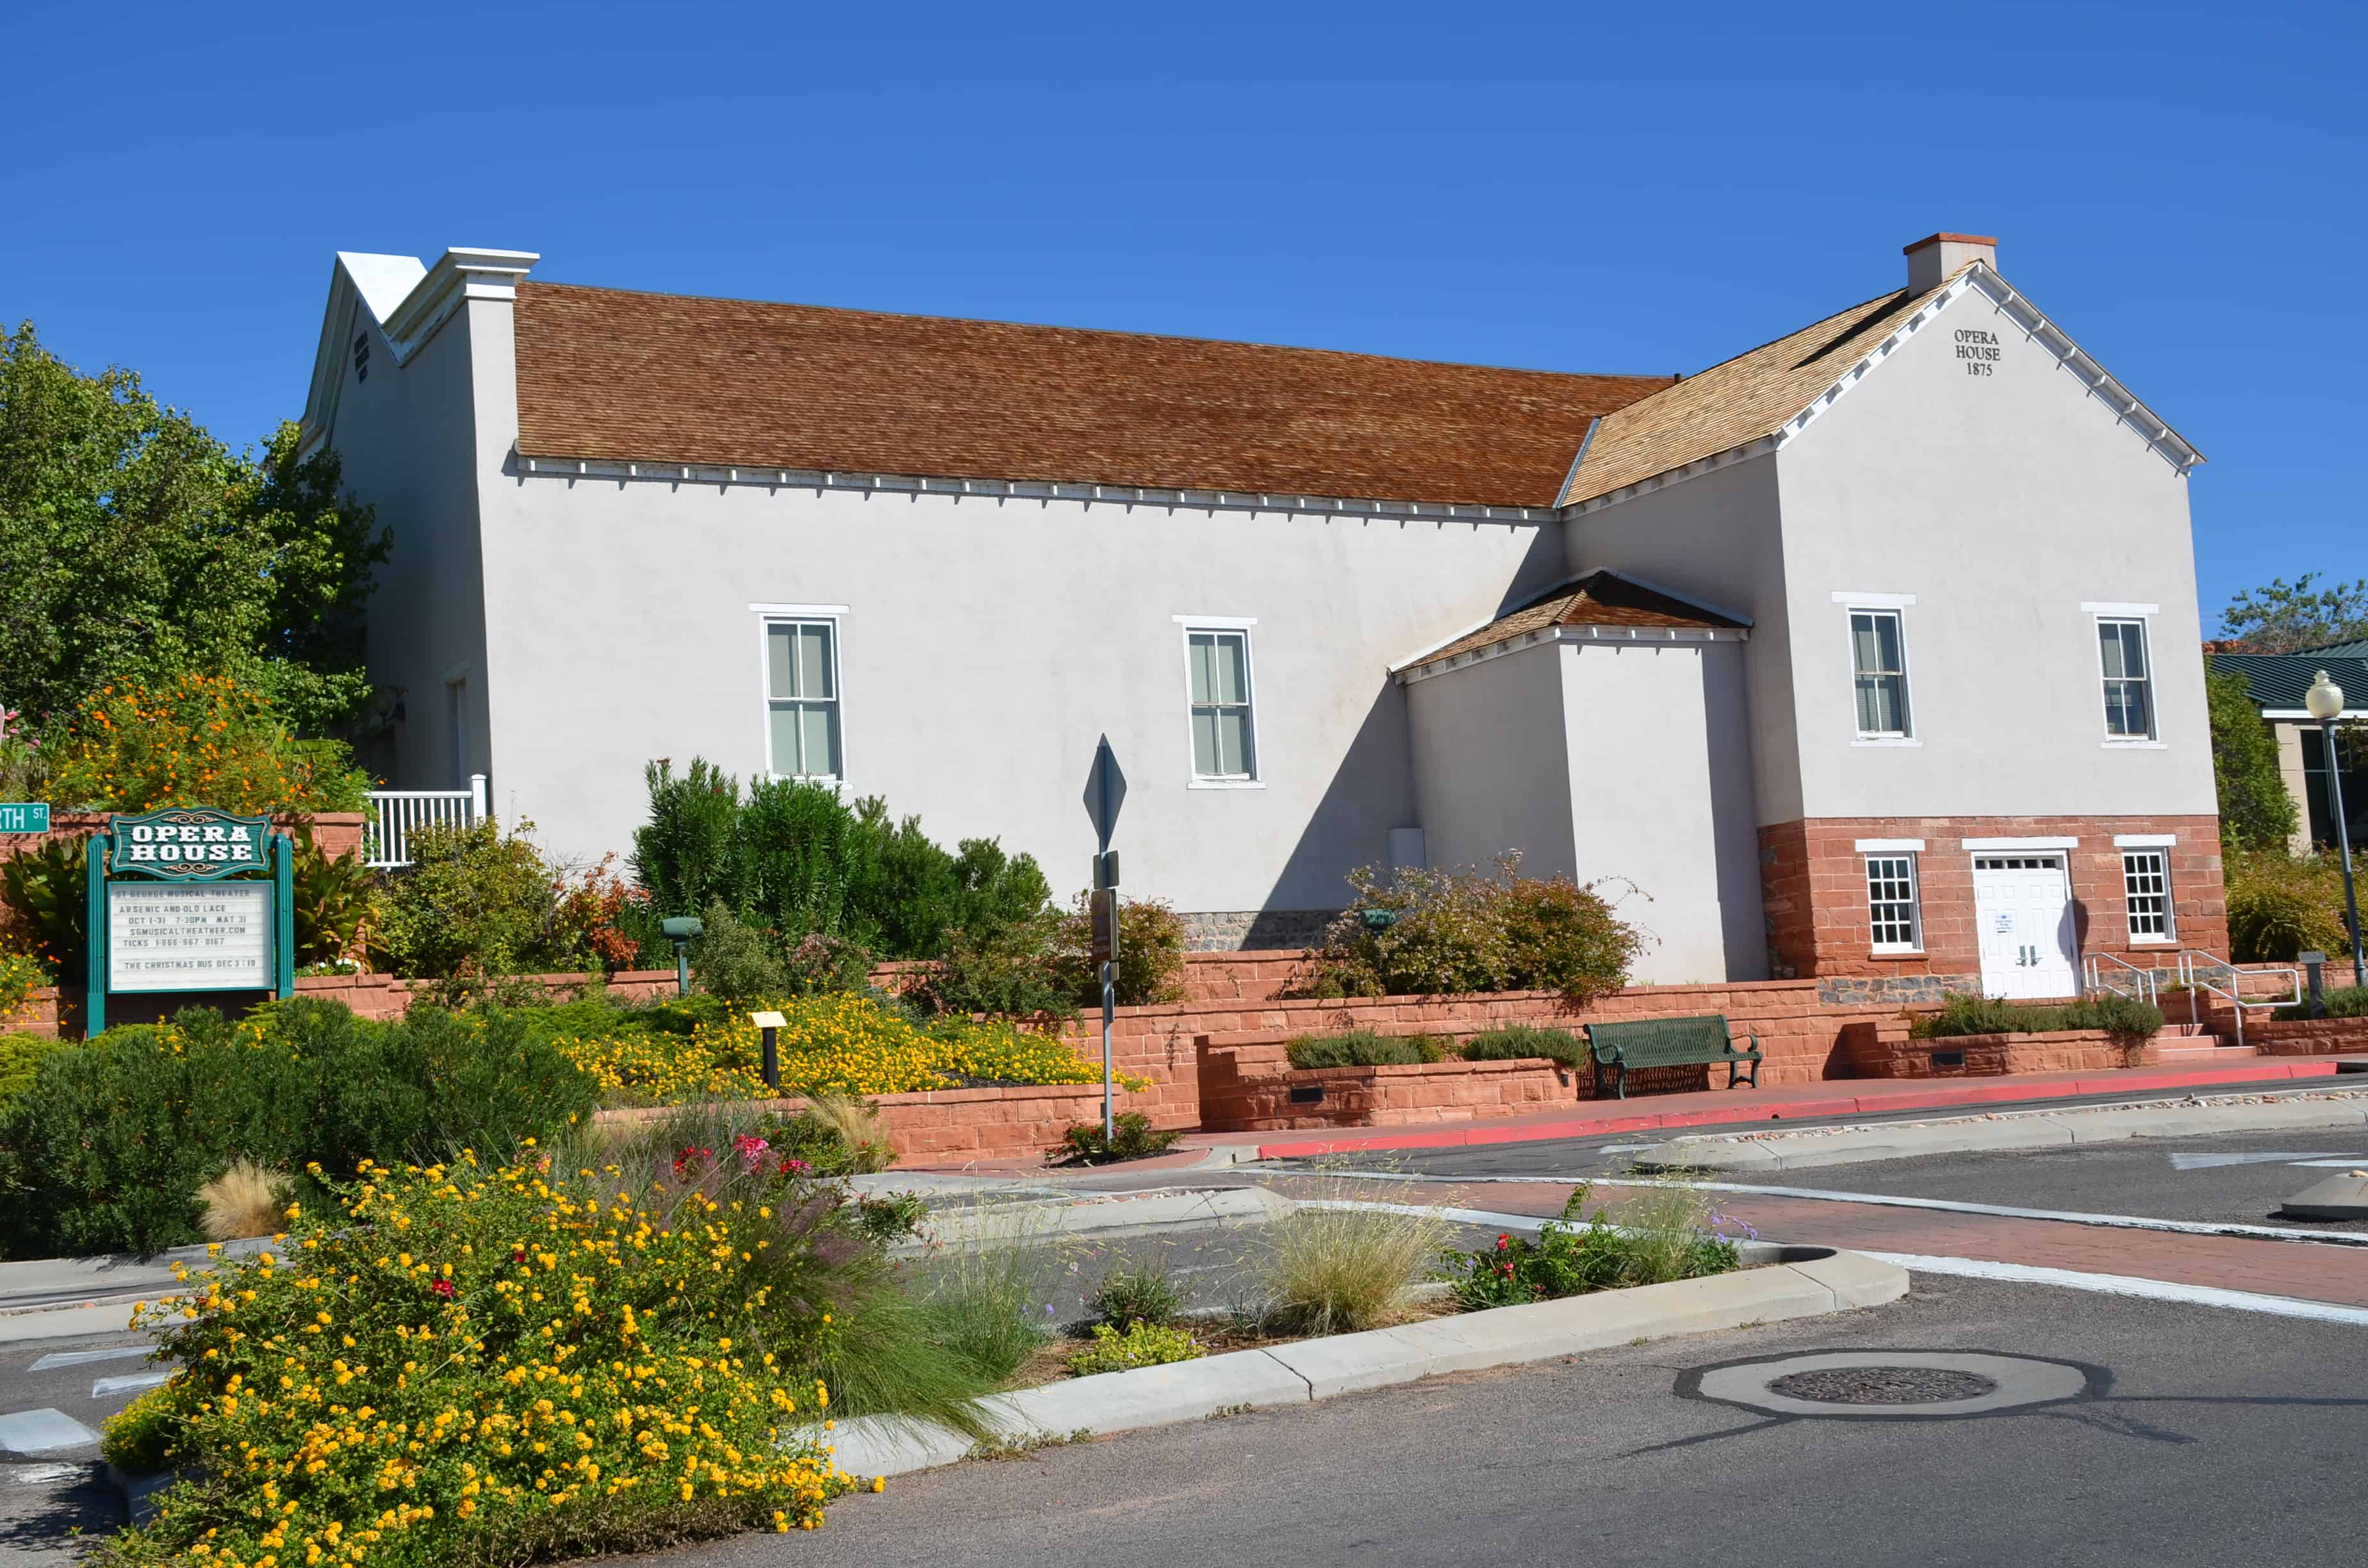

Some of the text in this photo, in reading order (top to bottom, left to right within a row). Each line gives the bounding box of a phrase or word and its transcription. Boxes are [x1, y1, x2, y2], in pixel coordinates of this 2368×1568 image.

[1954, 329, 1999, 345] OPERA
[1955, 345, 2001, 361] HOUSE
[1966, 363, 1993, 377] 1875
[0, 808, 47, 829] TH ST.
[132, 826, 251, 842] OPERA
[130, 845, 252, 861] HOUSE
[211, 889, 251, 897] THEATER
[129, 927, 246, 936] SGMUSICALTHEATHER.COM
[123, 939, 149, 947] TICKS
[145, 961, 194, 969] CHRISTMAS
[197, 960, 213, 968] BUS
